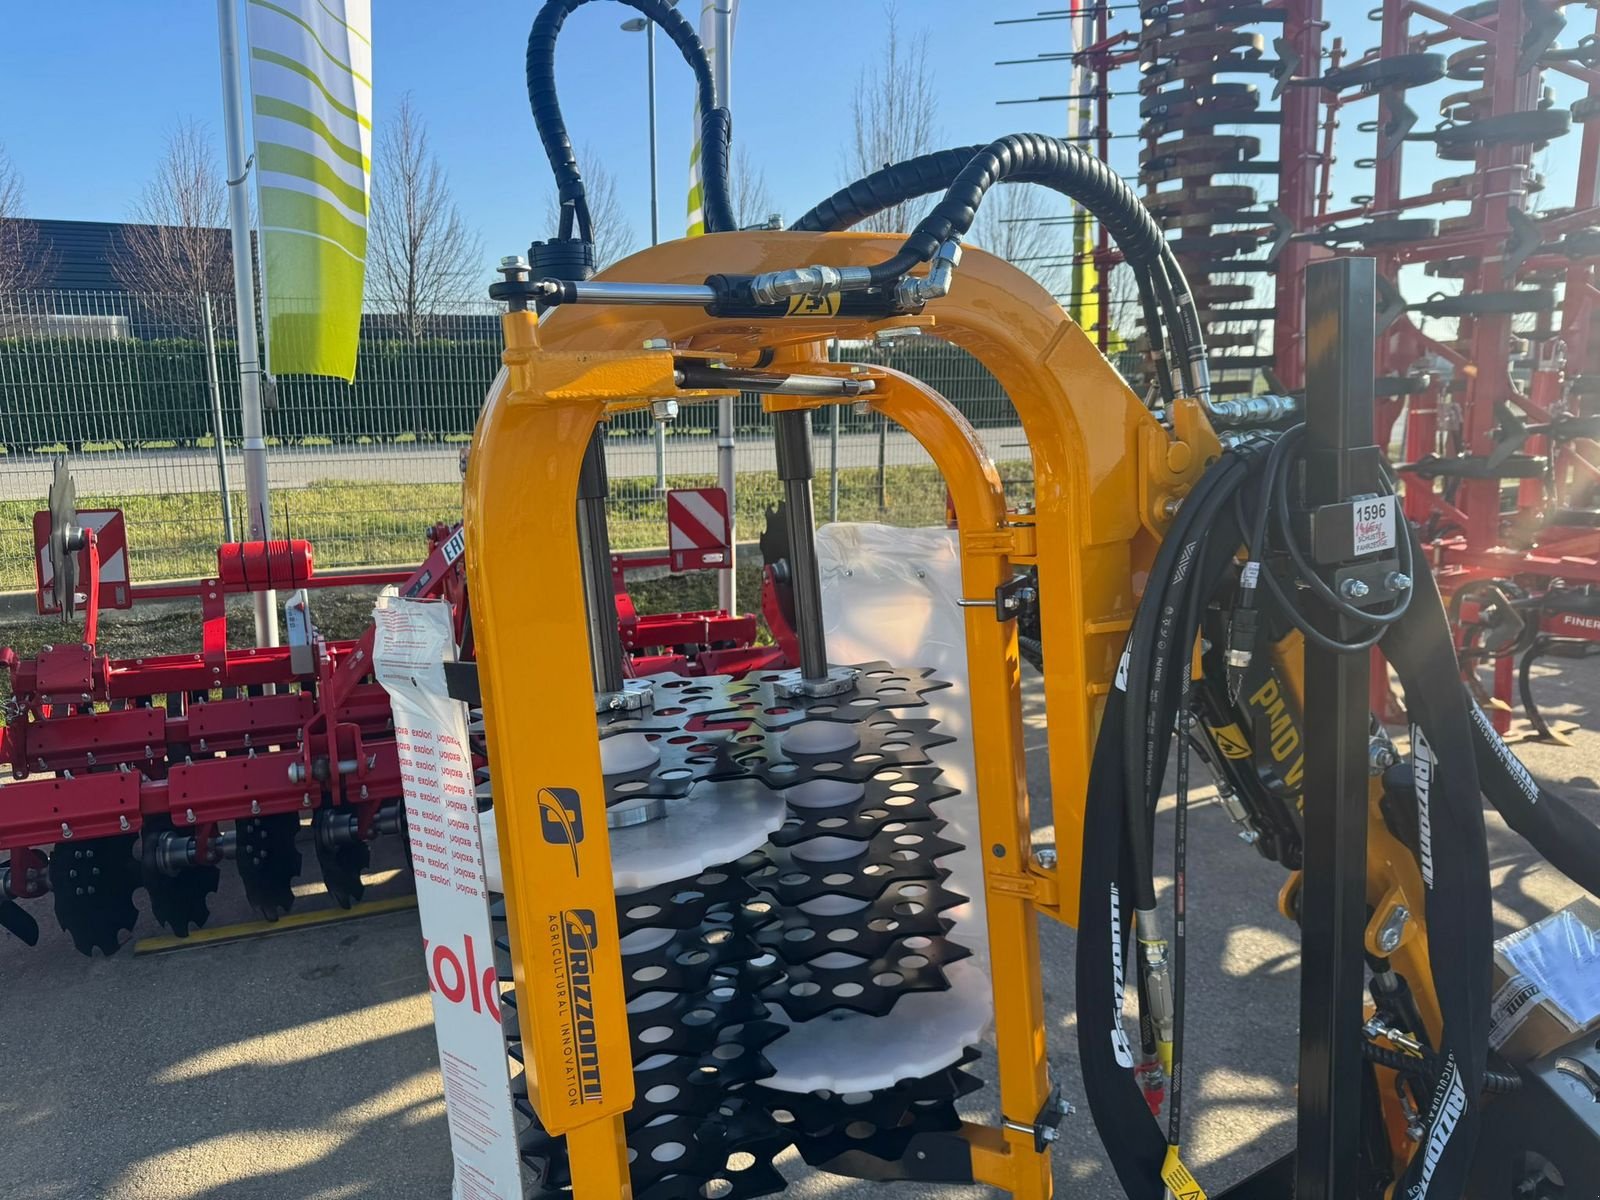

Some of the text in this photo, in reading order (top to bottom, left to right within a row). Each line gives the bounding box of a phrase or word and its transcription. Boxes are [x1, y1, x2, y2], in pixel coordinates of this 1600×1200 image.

[1357, 503, 1386, 522] 1596
[411, 728, 433, 740] exolon
[413, 744, 435, 756] exolon
[438, 750, 461, 762] exolon
[1470, 709, 1505, 763] AGRICULTURAL
[1504, 761, 1538, 805] INNOVATION
[415, 760, 437, 772] exolon
[441, 766, 463, 778] exolon
[418, 776, 439, 788] exolon
[443, 783, 465, 795] exolon
[420, 792, 441, 804] exolon
[446, 800, 468, 812] exolon
[422, 812, 443, 824] exolon
[448, 818, 470, 831] exolon
[424, 827, 445, 839] exolon
[450, 834, 472, 847] exolon
[426, 842, 447, 855] exolon
[452, 850, 474, 863] exolon
[428, 858, 449, 871] exolon
[454, 866, 476, 880] exolon
[430, 874, 451, 887] exolon
[456, 882, 478, 896] exolon
[548, 914, 579, 1107] AGRICULTURAL INNOVATION
